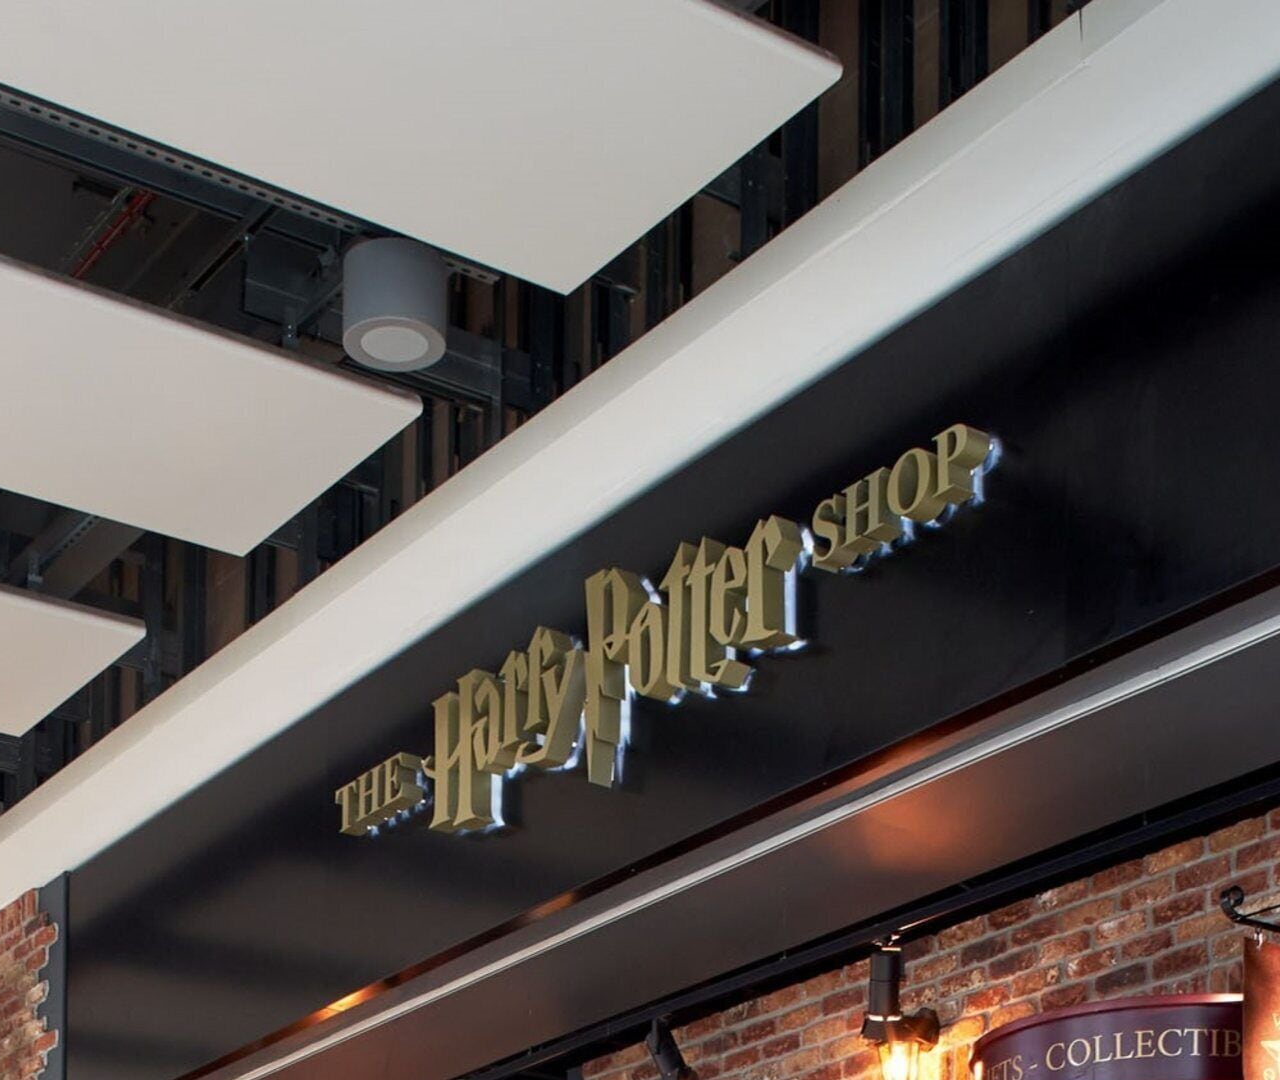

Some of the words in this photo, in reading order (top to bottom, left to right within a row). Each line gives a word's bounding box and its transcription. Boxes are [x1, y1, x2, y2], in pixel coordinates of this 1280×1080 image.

[335, 756, 424, 837] THE
[422, 625, 586, 832] Harry
[584, 515, 804, 788] Potter
[812, 422, 991, 572] SHOP
